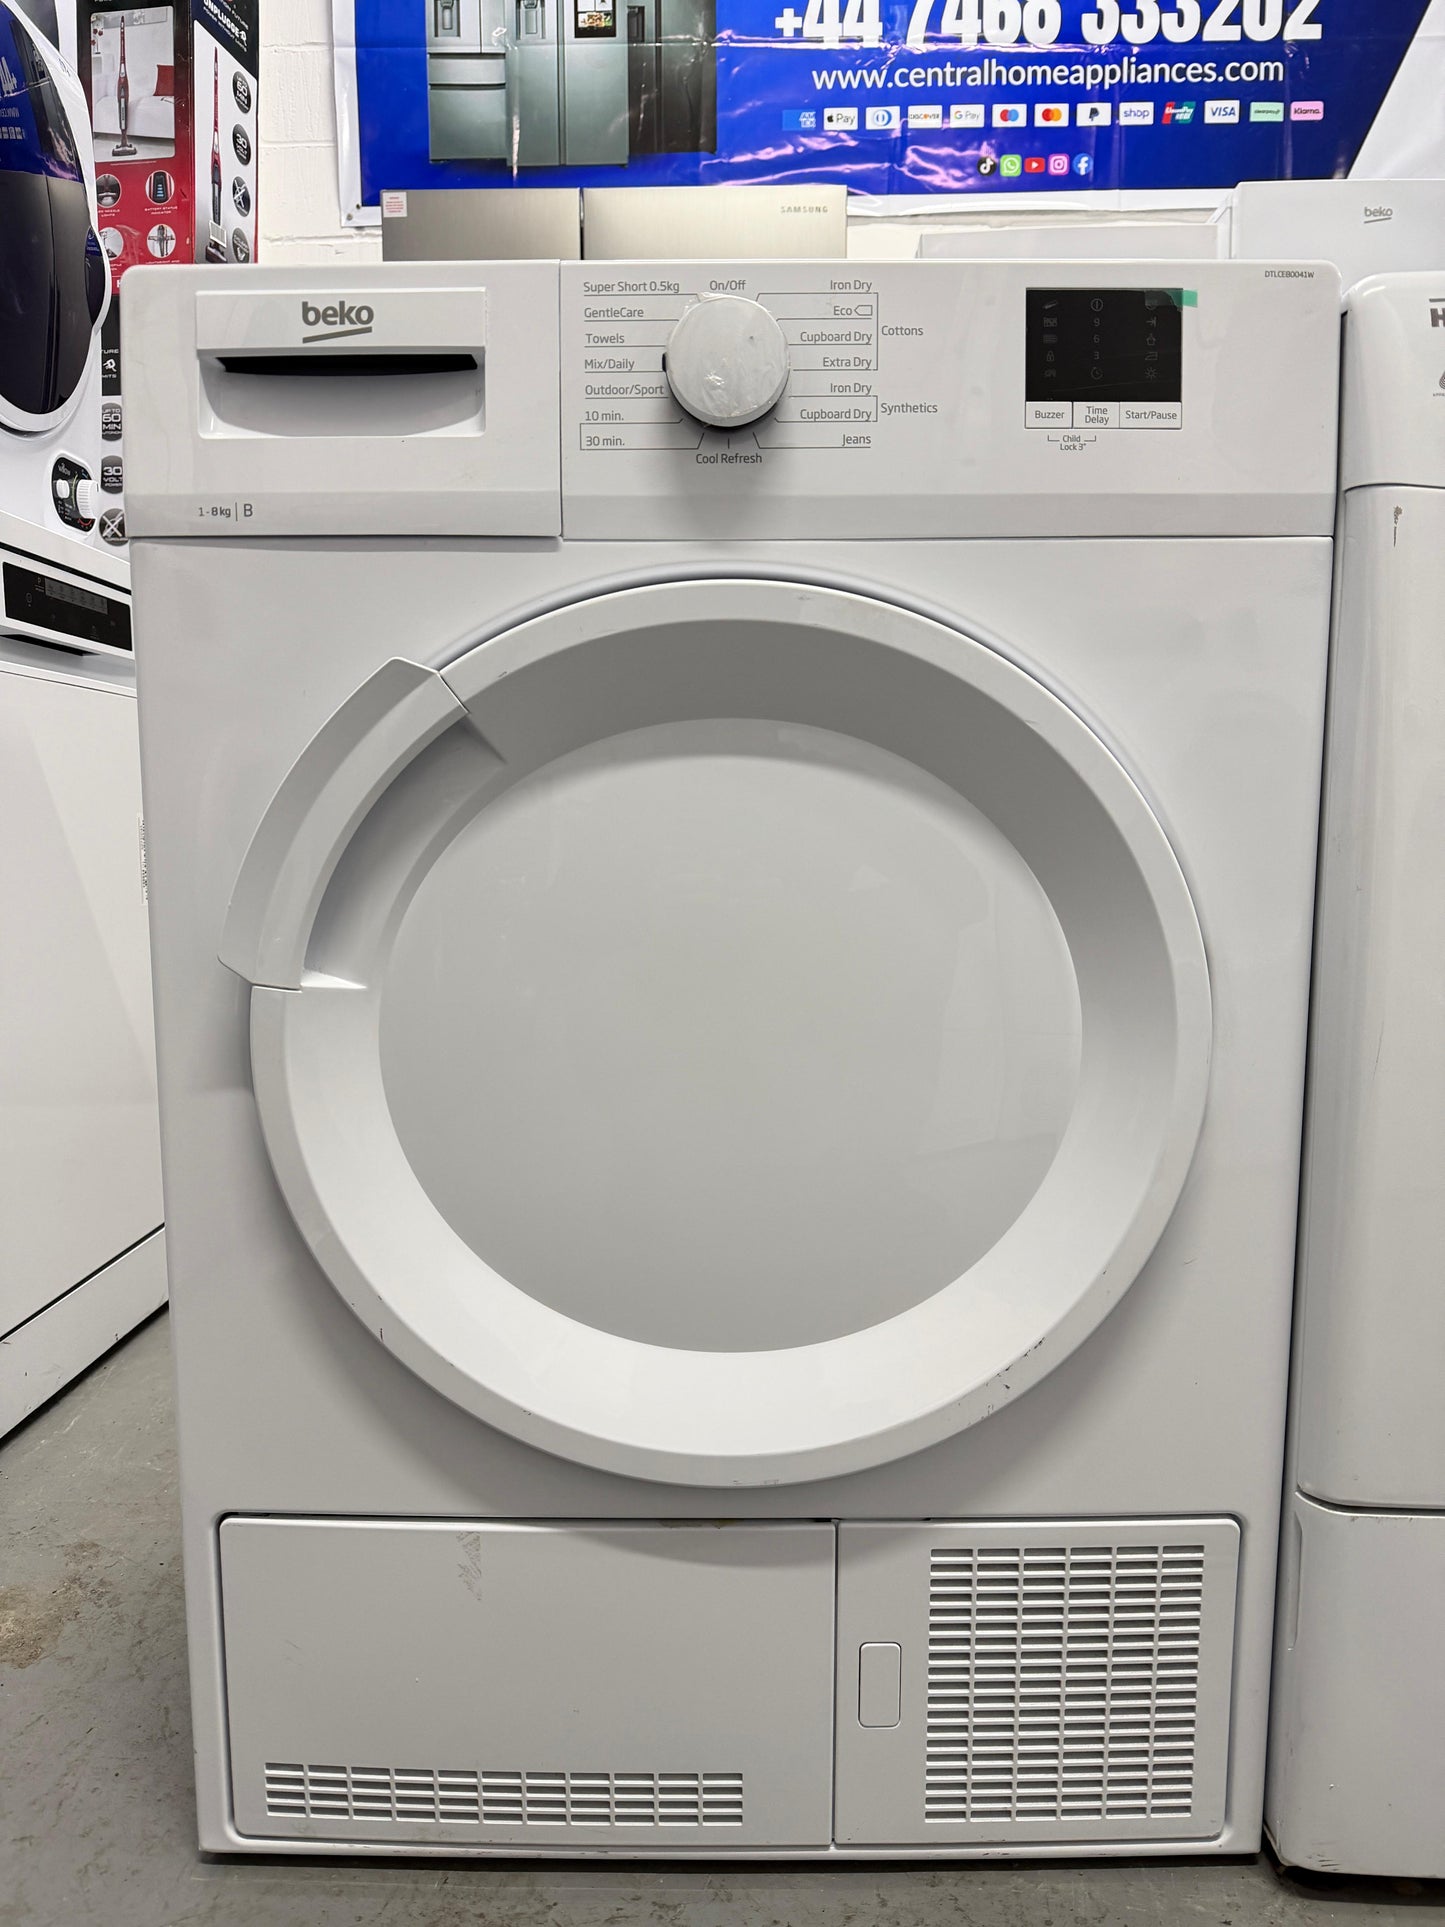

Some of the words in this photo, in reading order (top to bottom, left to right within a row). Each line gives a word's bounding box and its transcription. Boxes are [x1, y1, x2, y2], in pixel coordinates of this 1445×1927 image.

[811, 56, 1284, 91] www.centralhomeappliances.com
[1123, 107, 1150, 119] shop
[1210, 106, 1237, 117] VISA
[836, 112, 856, 126] Pay
[780, 205, 829, 214] SAMSUNG
[1364, 206, 1393, 217] beko
[583, 282, 615, 294] Super
[617, 281, 648, 292] Short
[649, 281, 680, 293] 0.5kg
[709, 280, 746, 291] On/Off
[830, 280, 851, 290] Iron
[853, 280, 873, 292] Dry
[302, 300, 375, 327] beko
[584, 307, 645, 318] GentleCare
[833, 306, 853, 316] Eco
[881, 325, 924, 336] Cottons
[585, 333, 625, 344] Towels
[800, 331, 851, 343] Cupboard
[853, 331, 873, 344] Dry
[584, 358, 635, 371] Mix/Daily
[822, 357, 851, 367] Extra
[853, 357, 873, 369] Dry
[584, 384, 665, 396] Outdoor/Sport
[830, 382, 851, 393] Iron
[853, 382, 873, 395] Dry
[880, 402, 938, 415] Synthetics
[1086, 406, 1108, 415] Time
[102, 413, 121, 423] 60
[584, 411, 599, 421] 10
[601, 411, 624, 421] min.
[800, 408, 851, 421] Cupboard
[853, 408, 873, 421] Dry
[1034, 410, 1065, 419] Buzzer
[1084, 415, 1109, 425] Delay
[1125, 410, 1178, 420] Start/Pause
[102, 423, 121, 431] MIN
[585, 436, 600, 446] 30
[602, 436, 625, 446] min.
[841, 434, 872, 447] Jeans
[1059, 443, 1077, 451] Lock
[695, 453, 718, 464] Cool
[720, 453, 762, 464] Refresh
[103, 466, 122, 476] 30
[243, 503, 253, 517] B
